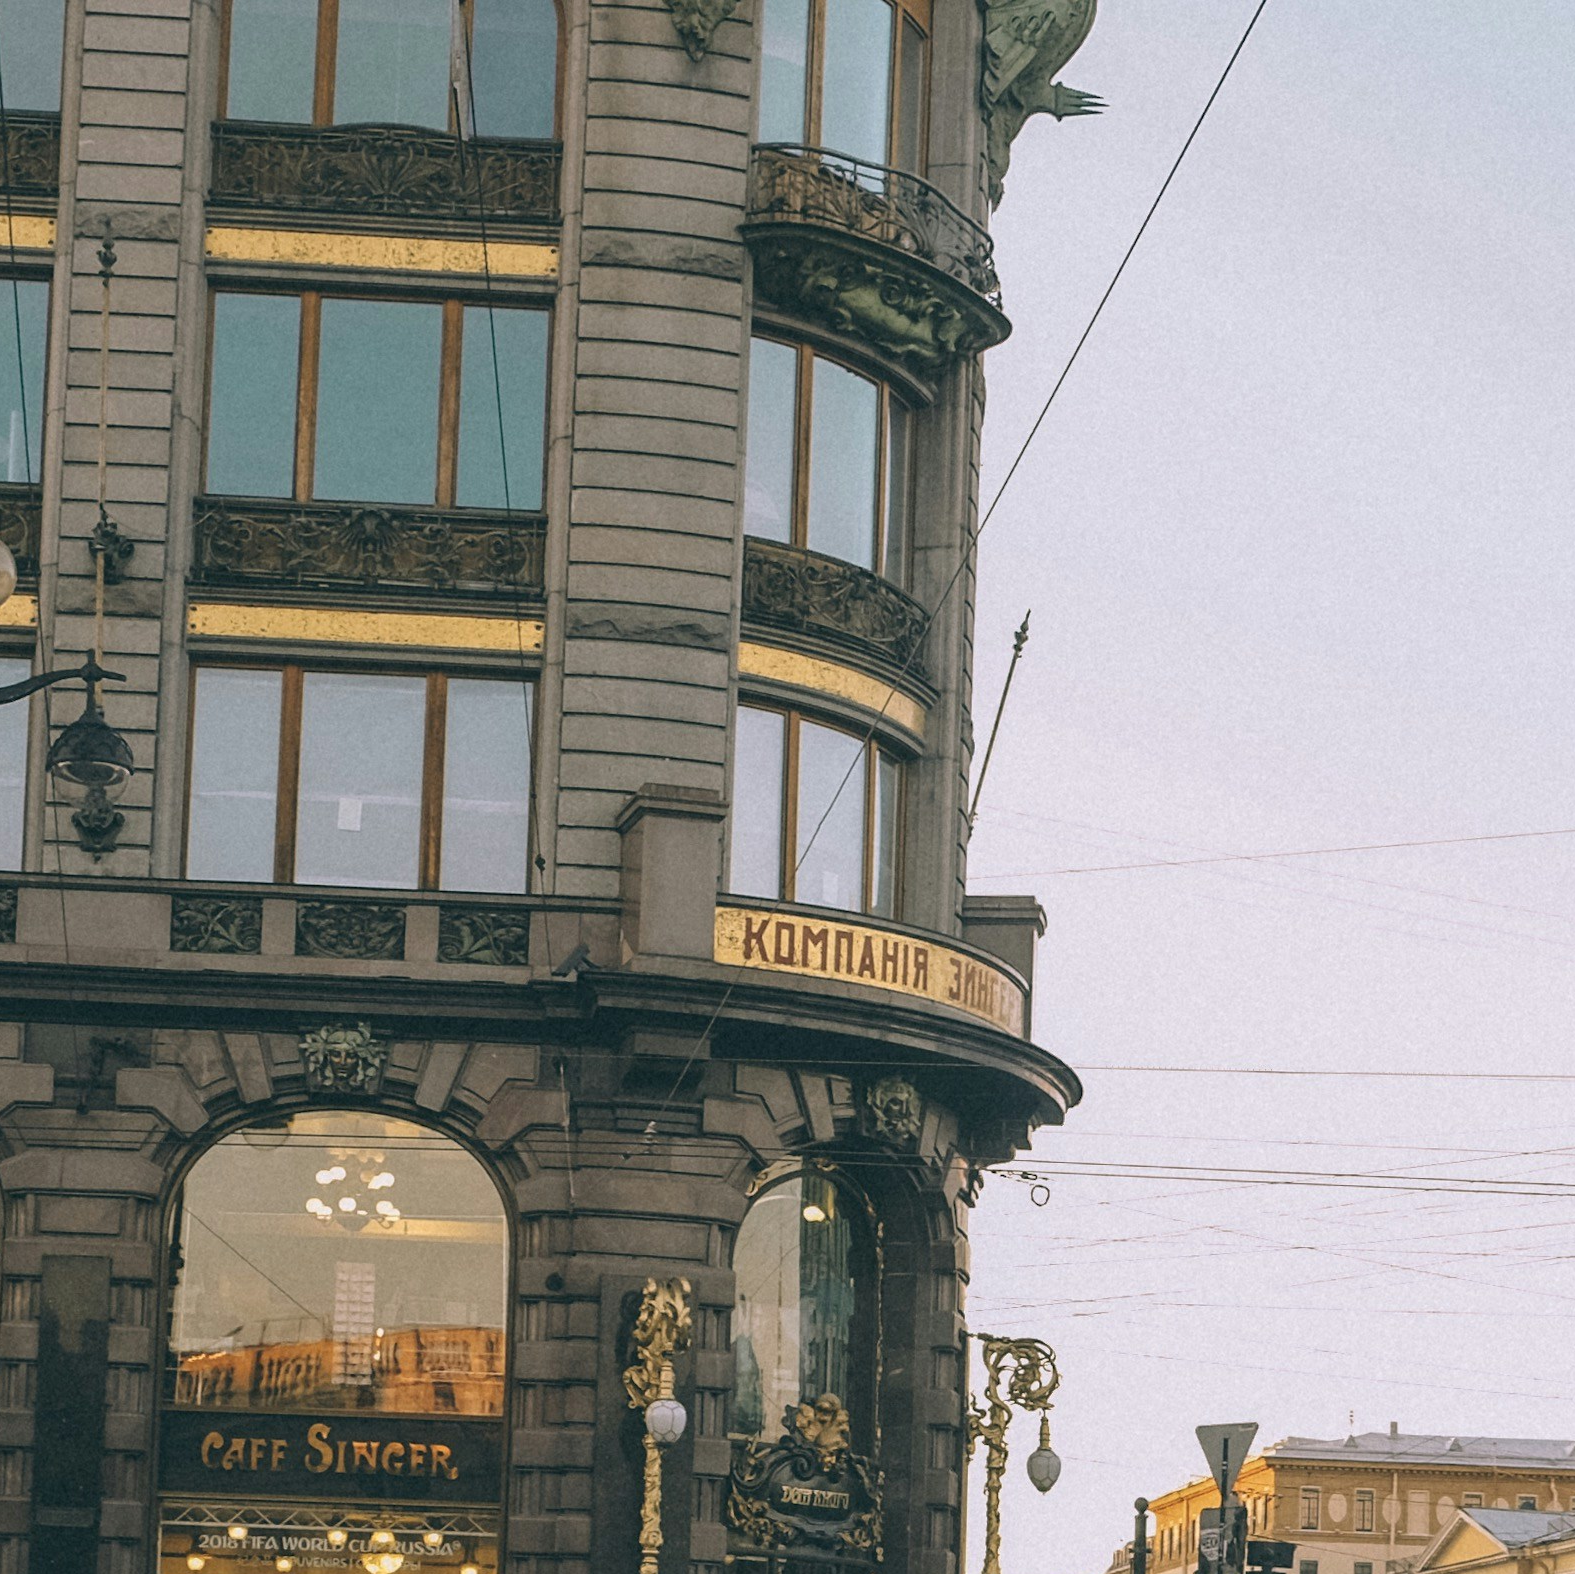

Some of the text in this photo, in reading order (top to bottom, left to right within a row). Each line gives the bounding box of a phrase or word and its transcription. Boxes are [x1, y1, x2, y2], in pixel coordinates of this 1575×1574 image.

[201, 1430, 289, 1471] CAFE
[198, 1533, 239, 1550] 2018
[241, 1535, 278, 1551] FIFA
[282, 1536, 344, 1553] WORLD
